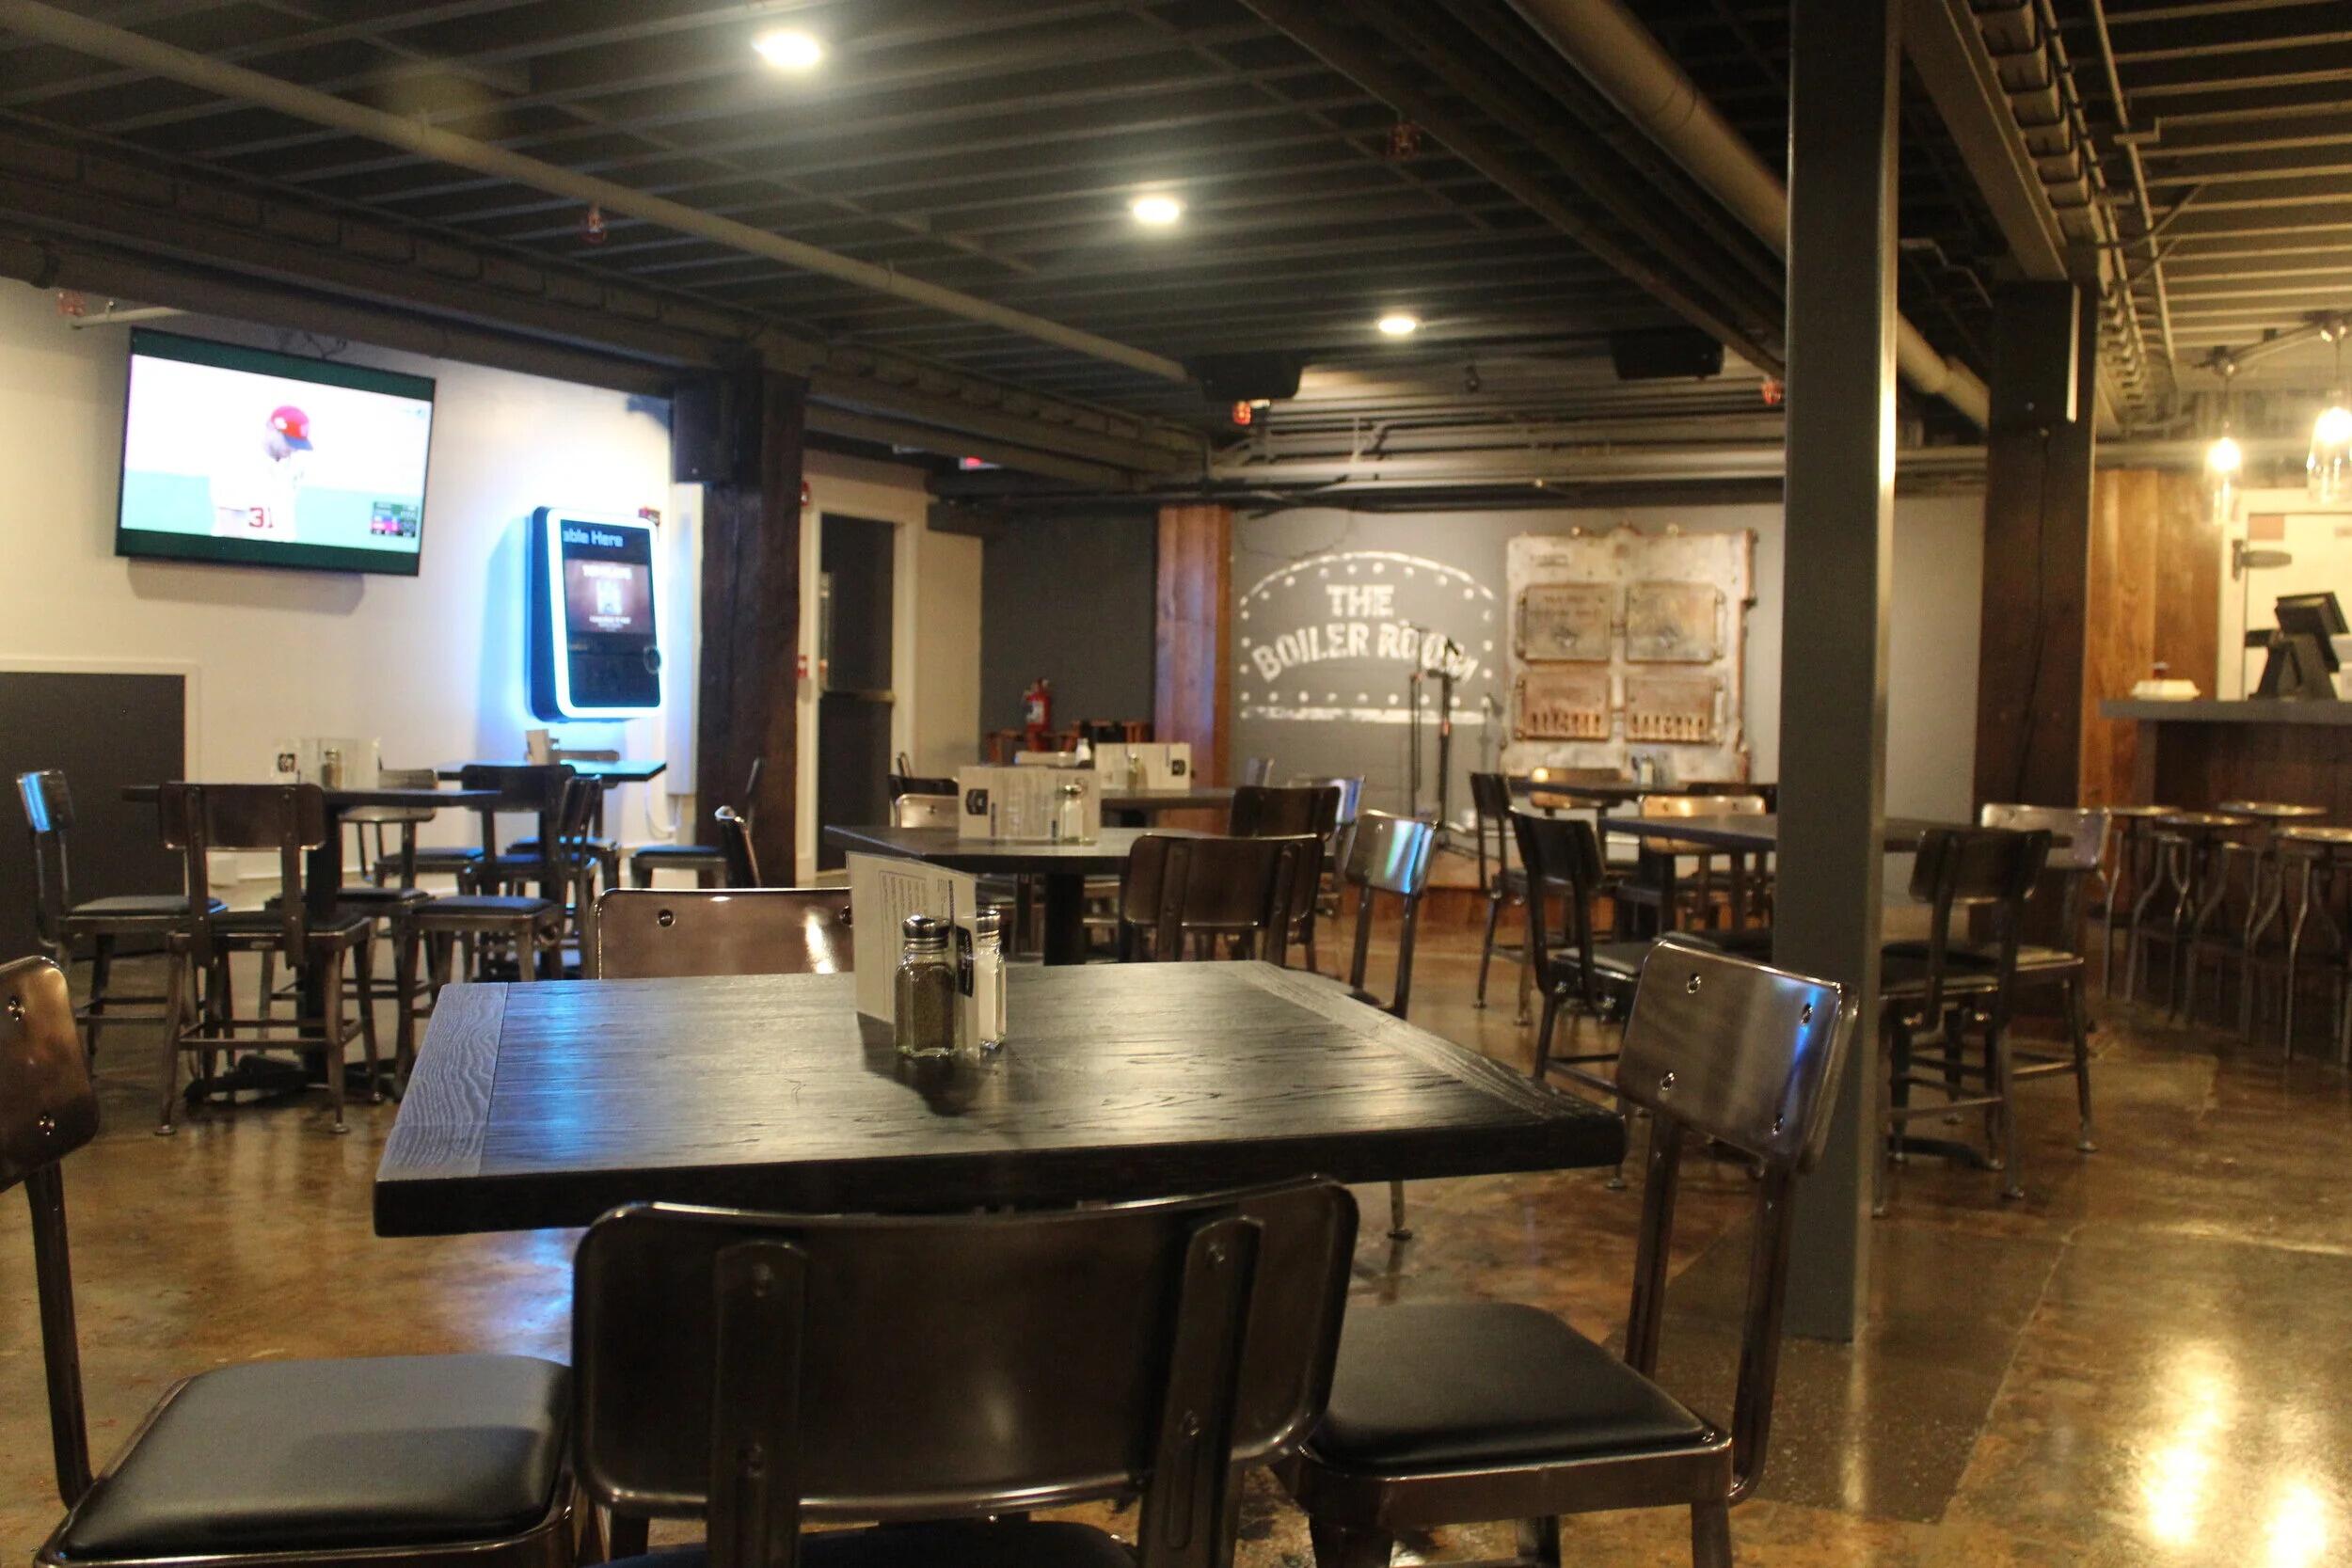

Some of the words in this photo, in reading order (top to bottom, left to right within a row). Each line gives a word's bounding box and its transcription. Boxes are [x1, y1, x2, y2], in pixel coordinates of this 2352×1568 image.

[248, 506, 274, 529] 31
[591, 530, 623, 547] Here
[1325, 584, 1394, 617] THE
[1251, 622, 1370, 683] BOILER
